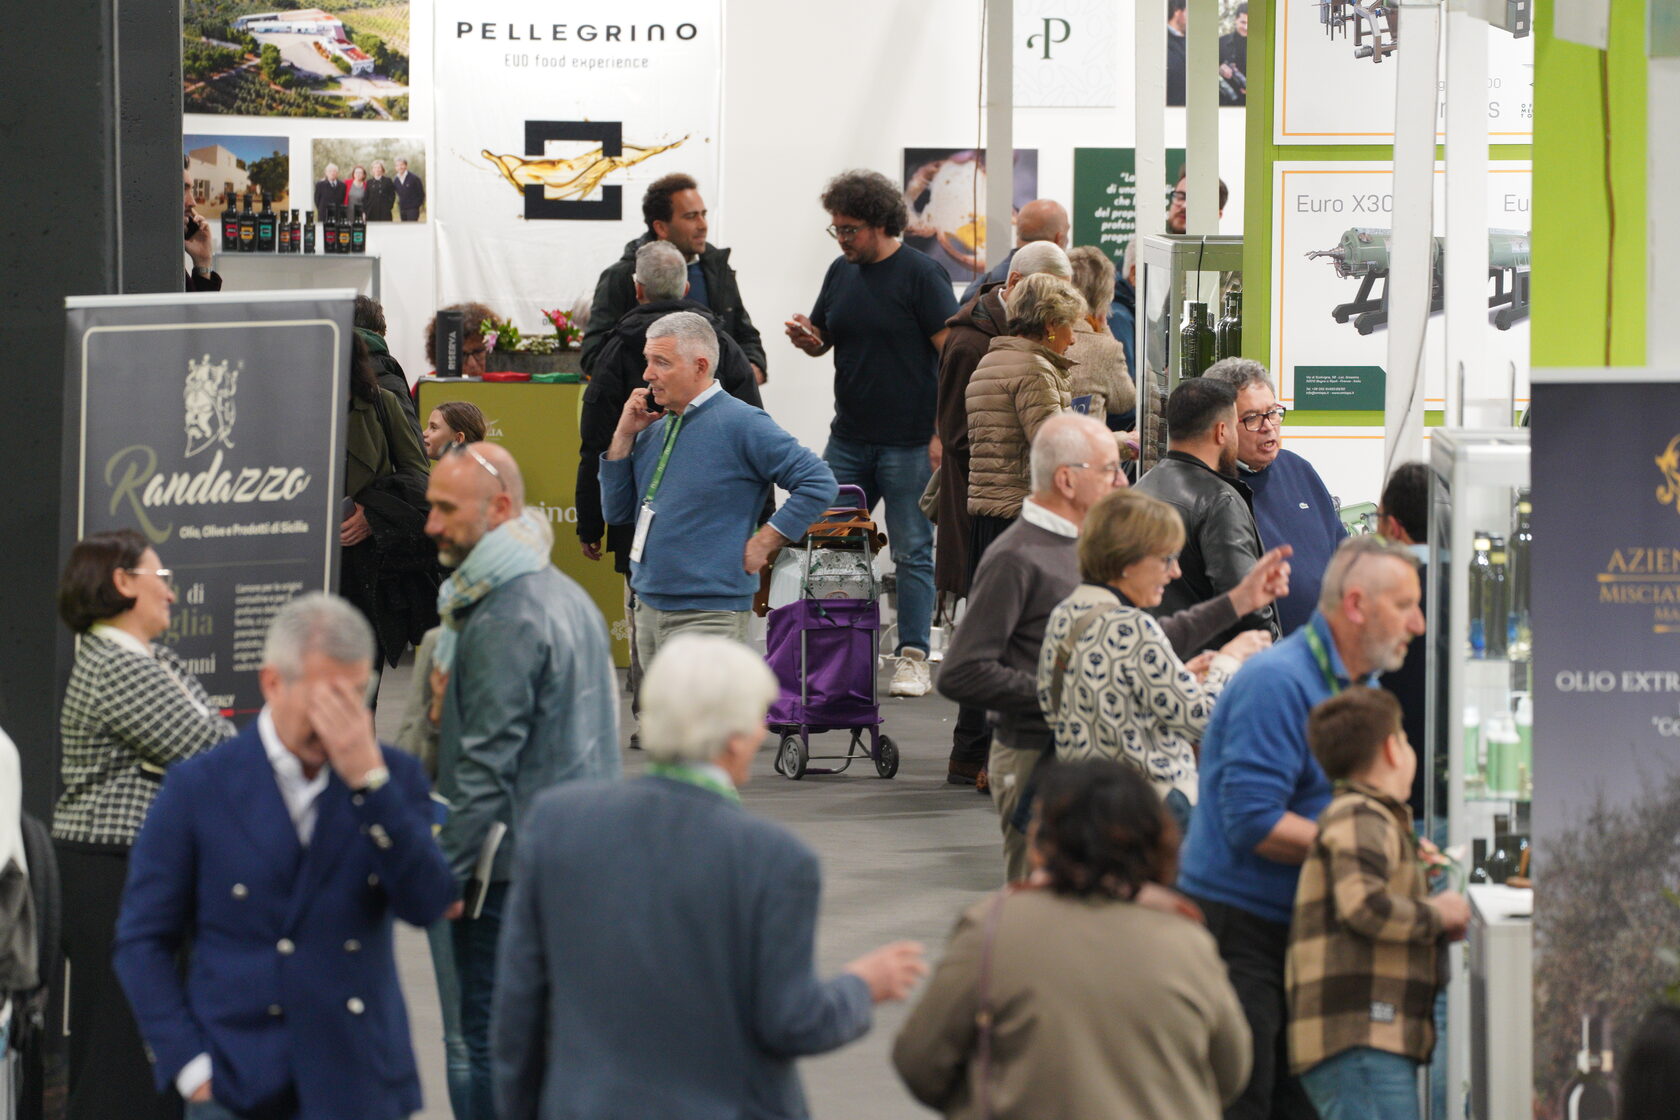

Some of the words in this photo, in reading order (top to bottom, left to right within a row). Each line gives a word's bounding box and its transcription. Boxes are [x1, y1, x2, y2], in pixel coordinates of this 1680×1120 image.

[456, 22, 697, 42] PELLEGRINO
[535, 54, 566, 68] food
[572, 56, 649, 70] experience
[1113, 195, 1131, 206] che
[1296, 194, 1344, 213] Euro
[1094, 207, 1110, 217] del
[448, 331, 457, 370] RISERVA
[104, 444, 312, 544] Randazzo
[281, 520, 310, 534] Sicilia
[187, 583, 205, 605] di
[1555, 670, 1617, 692] OLIO
